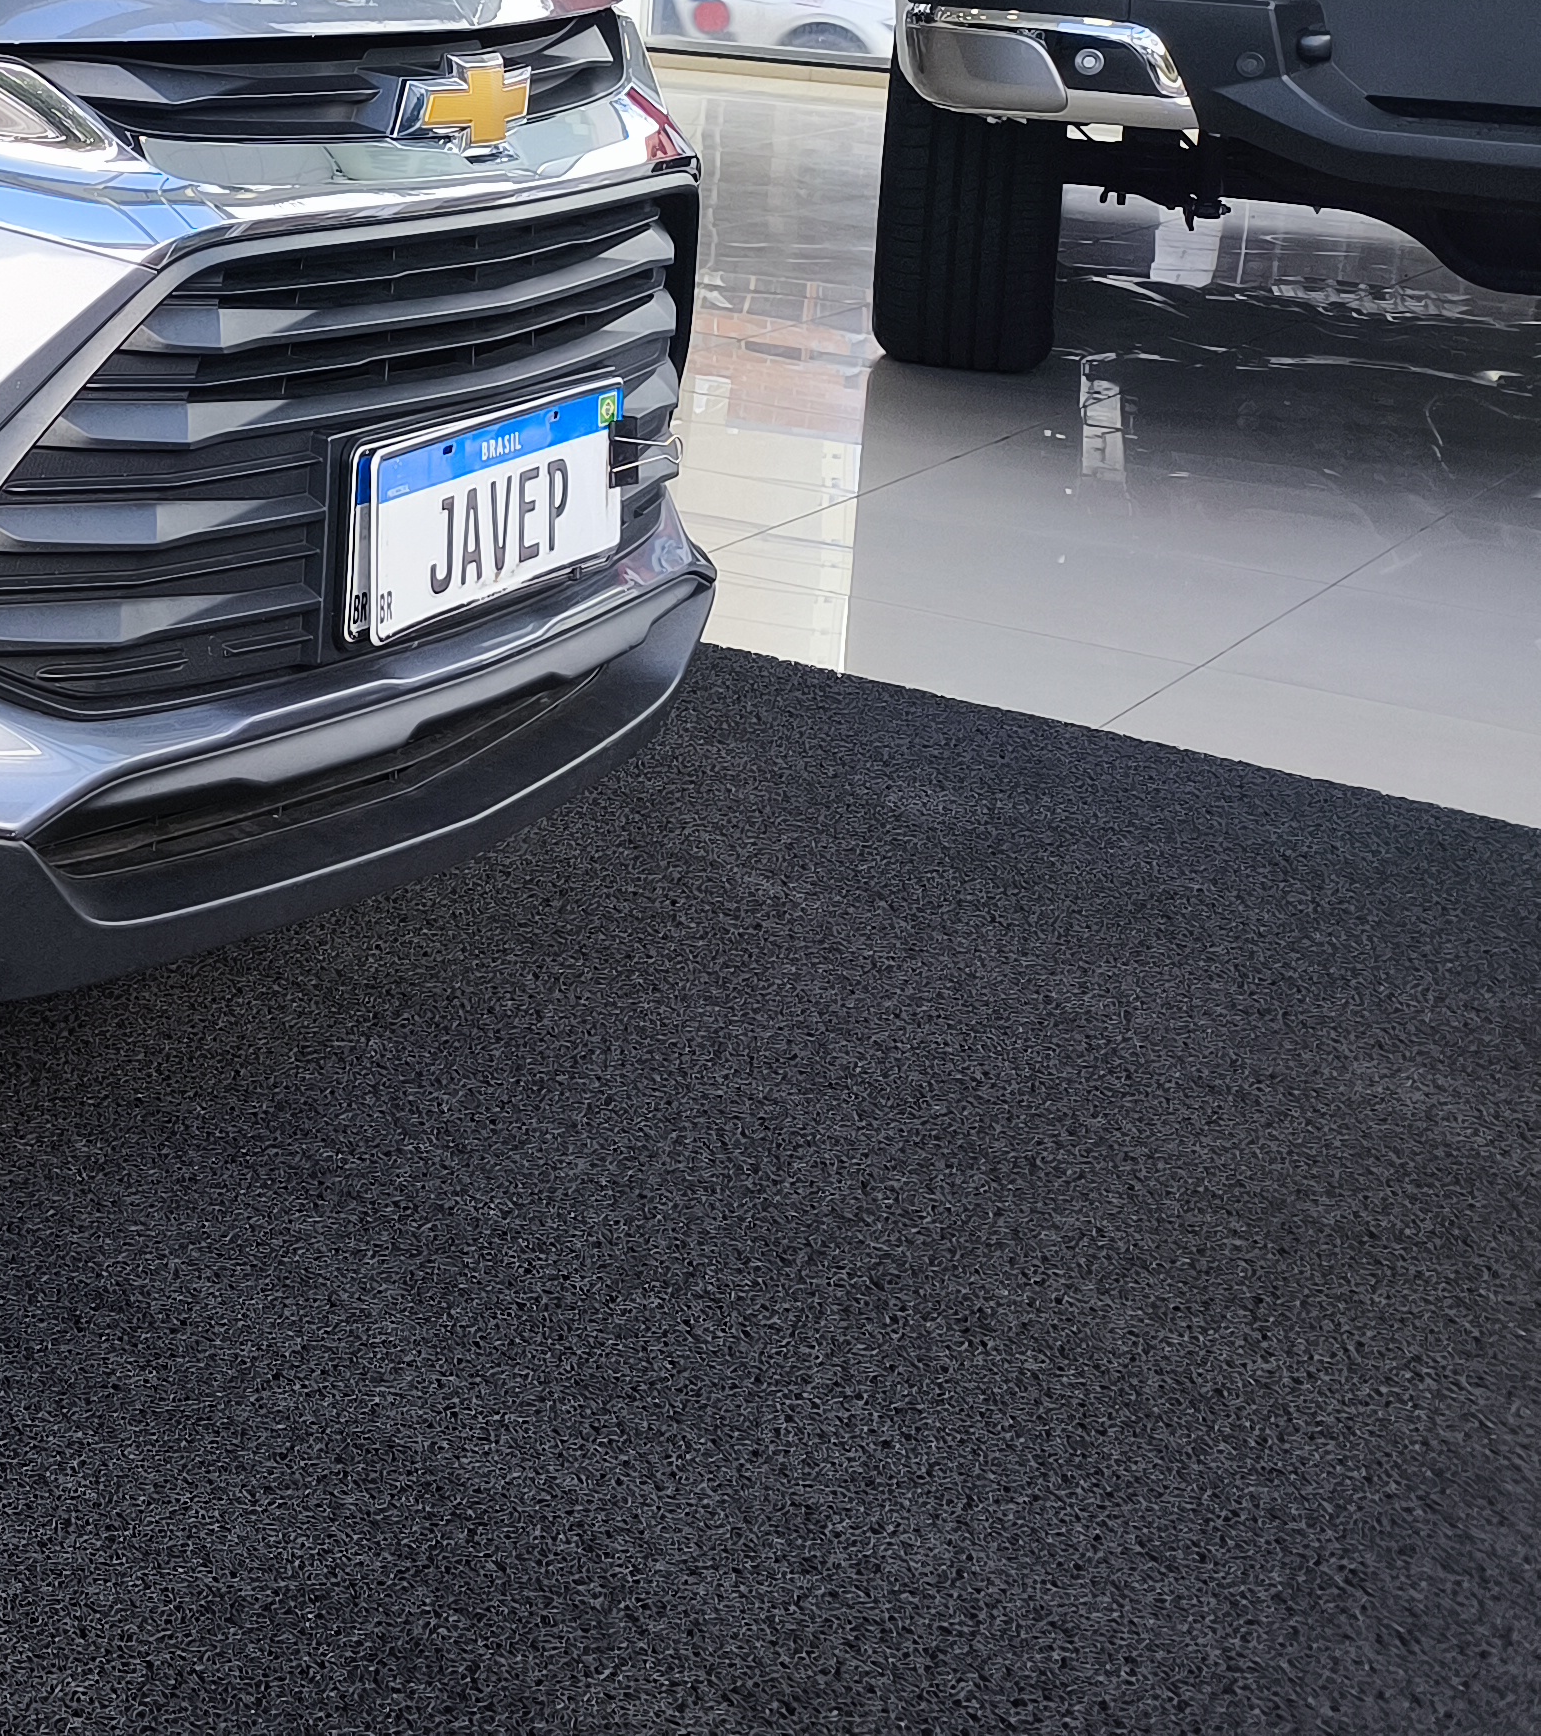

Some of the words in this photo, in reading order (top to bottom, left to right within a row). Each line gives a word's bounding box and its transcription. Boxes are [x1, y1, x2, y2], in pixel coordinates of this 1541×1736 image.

[481, 432, 522, 462] BRASIL
[430, 458, 568, 595] JAVEP
[353, 591, 368, 624] BR
[379, 590, 392, 625] BR
